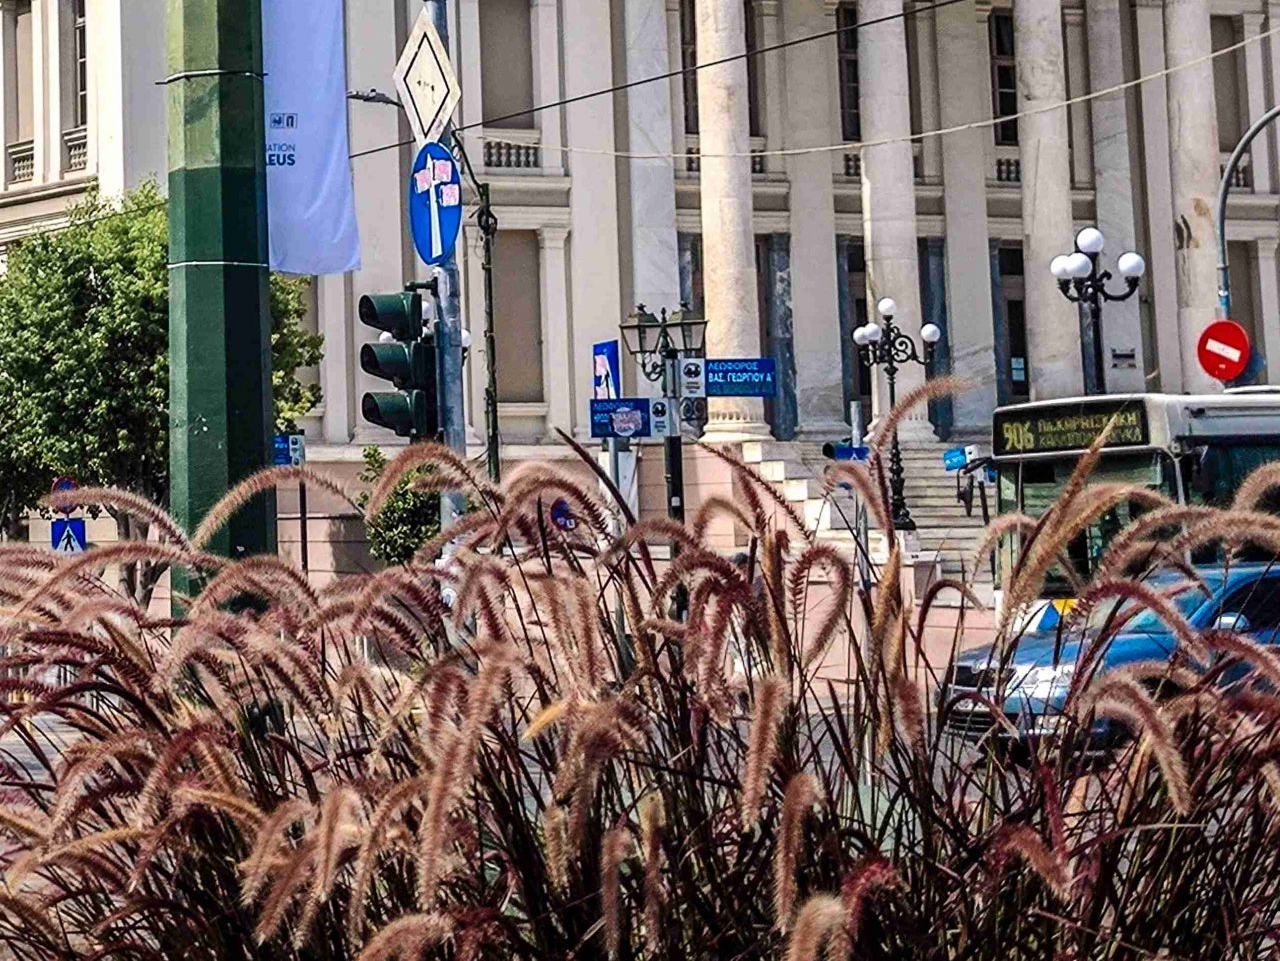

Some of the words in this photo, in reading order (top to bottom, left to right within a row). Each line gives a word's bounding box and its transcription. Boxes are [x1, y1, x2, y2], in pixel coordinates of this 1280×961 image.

[266, 153, 296, 166] EUS
[708, 361, 759, 371] ΛΕΩΦΟΡΟΣ
[1002, 421, 1034, 450] 906
